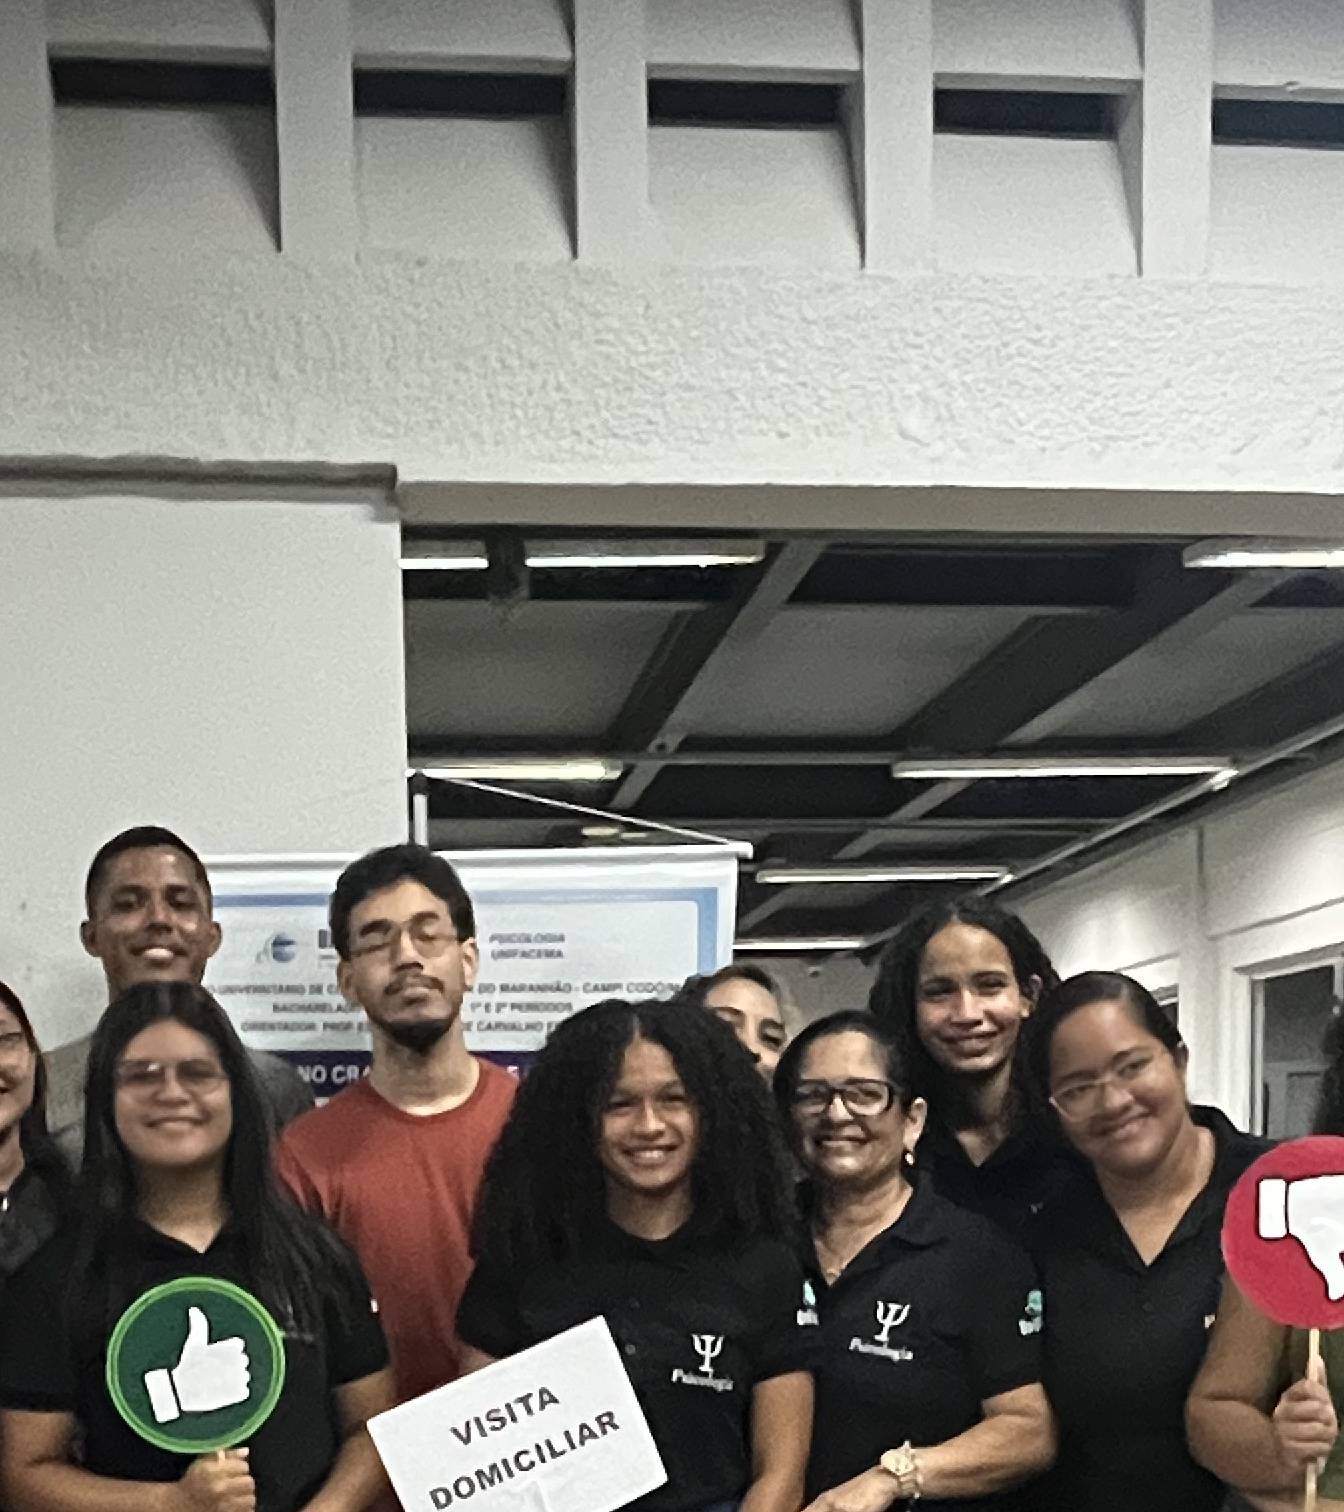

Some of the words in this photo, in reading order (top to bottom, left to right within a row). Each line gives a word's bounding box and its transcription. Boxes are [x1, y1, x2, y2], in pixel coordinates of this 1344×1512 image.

[489, 932, 565, 944] PSICOLOGIA
[479, 983, 495, 993] DO
[500, 980, 571, 993] MARANHÃO
[476, 1021, 543, 1032] CARVALHO
[449, 1386, 560, 1446] VISITA
[428, 1410, 620, 1510] DOMICILIAR
